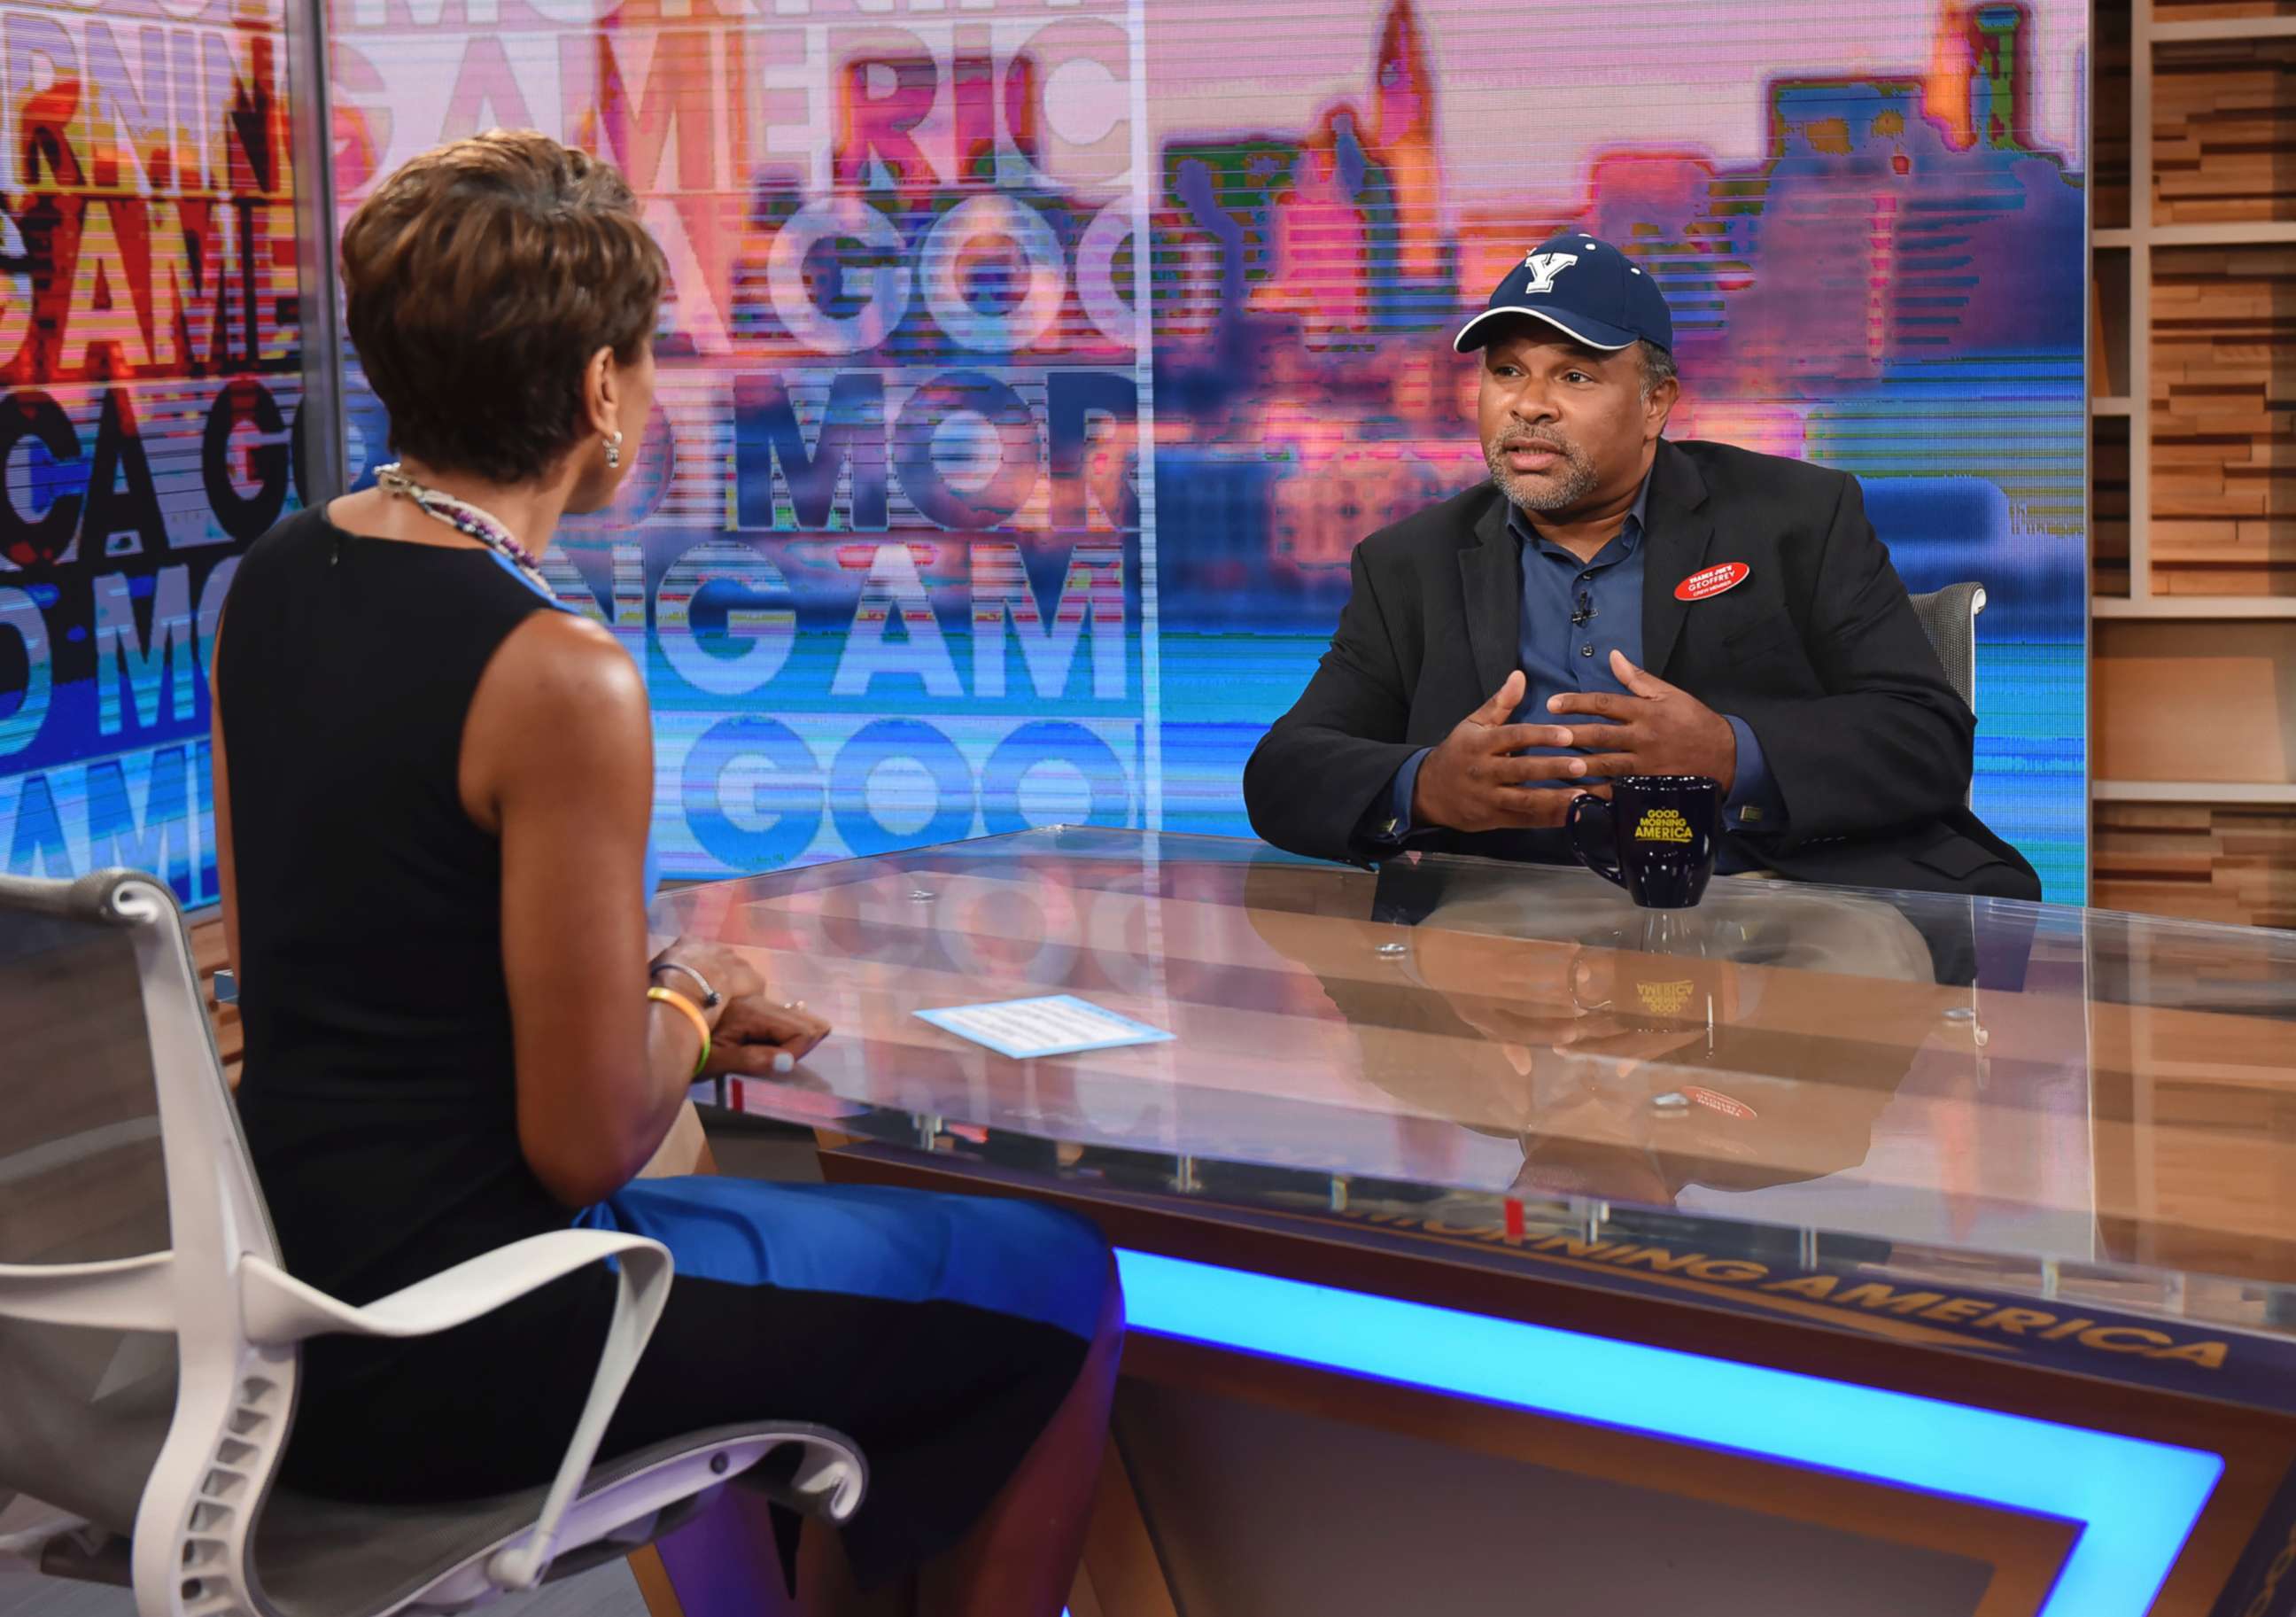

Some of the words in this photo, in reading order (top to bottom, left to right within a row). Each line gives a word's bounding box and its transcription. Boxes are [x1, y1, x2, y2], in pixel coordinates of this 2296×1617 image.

[3, 12, 293, 196] RNIN
[1524, 252, 1578, 294] Y
[1687, 570, 1736, 592] GEOFFREY
[831, 541, 1128, 699] AM
[7, 735, 221, 904] AM
[680, 715, 1144, 872] GOO
[1640, 817, 1687, 827] MORNING
[1647, 809, 1679, 819] GOOD
[1634, 825, 1693, 838] AMERICA
[1758, 1273, 2230, 1370] AMERICA
